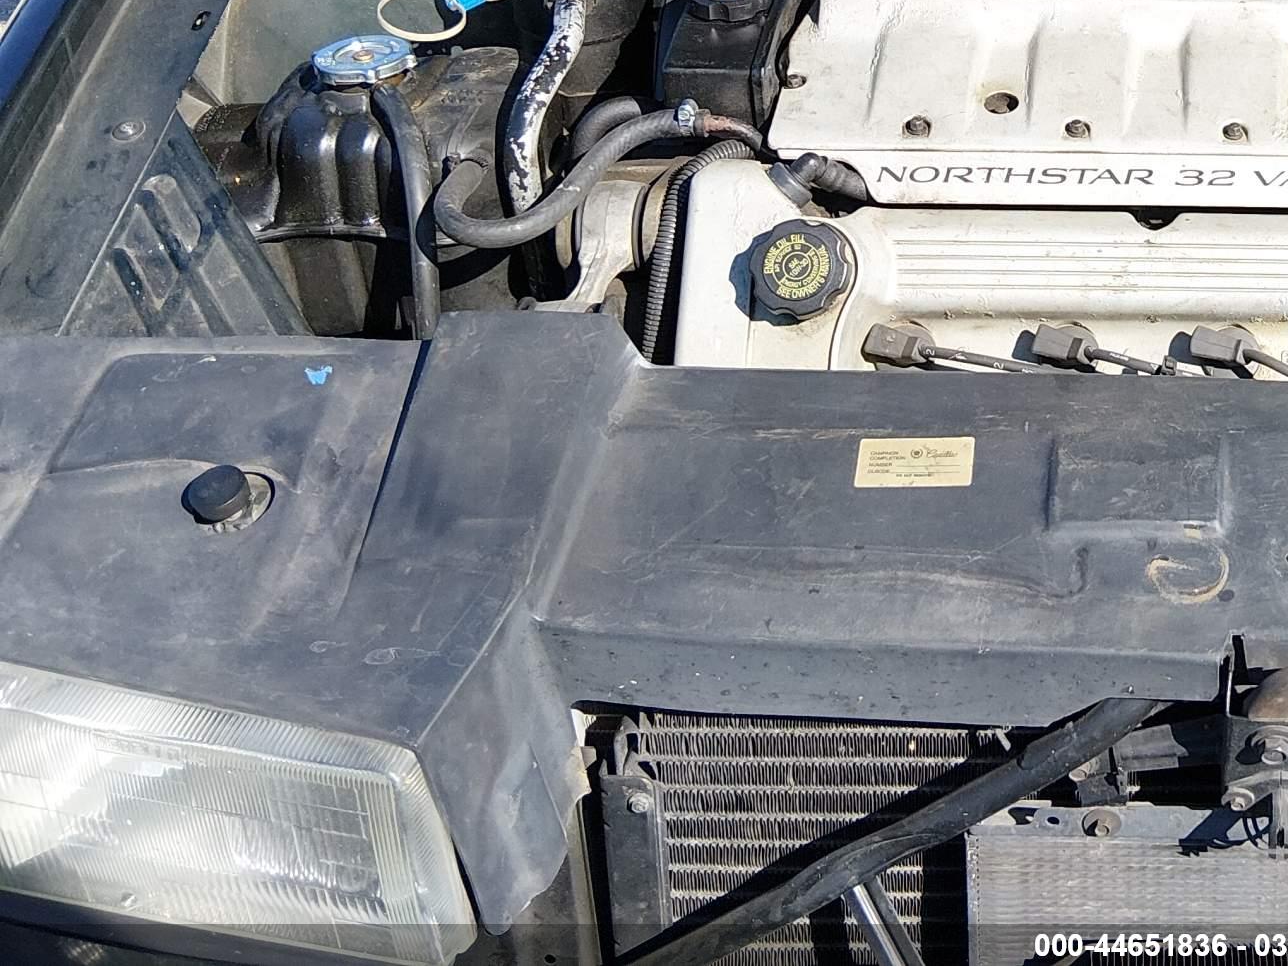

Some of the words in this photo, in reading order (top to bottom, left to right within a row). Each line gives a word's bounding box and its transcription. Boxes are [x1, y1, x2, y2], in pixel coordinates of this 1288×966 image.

[876, 165, 1156, 186] NORTHSTAR
[1175, 168, 1237, 187] 32
[763, 247, 777, 275] ENGINE
[776, 238, 786, 248] OIL
[791, 234, 805, 243] FILL
[777, 286, 791, 298] SEE
